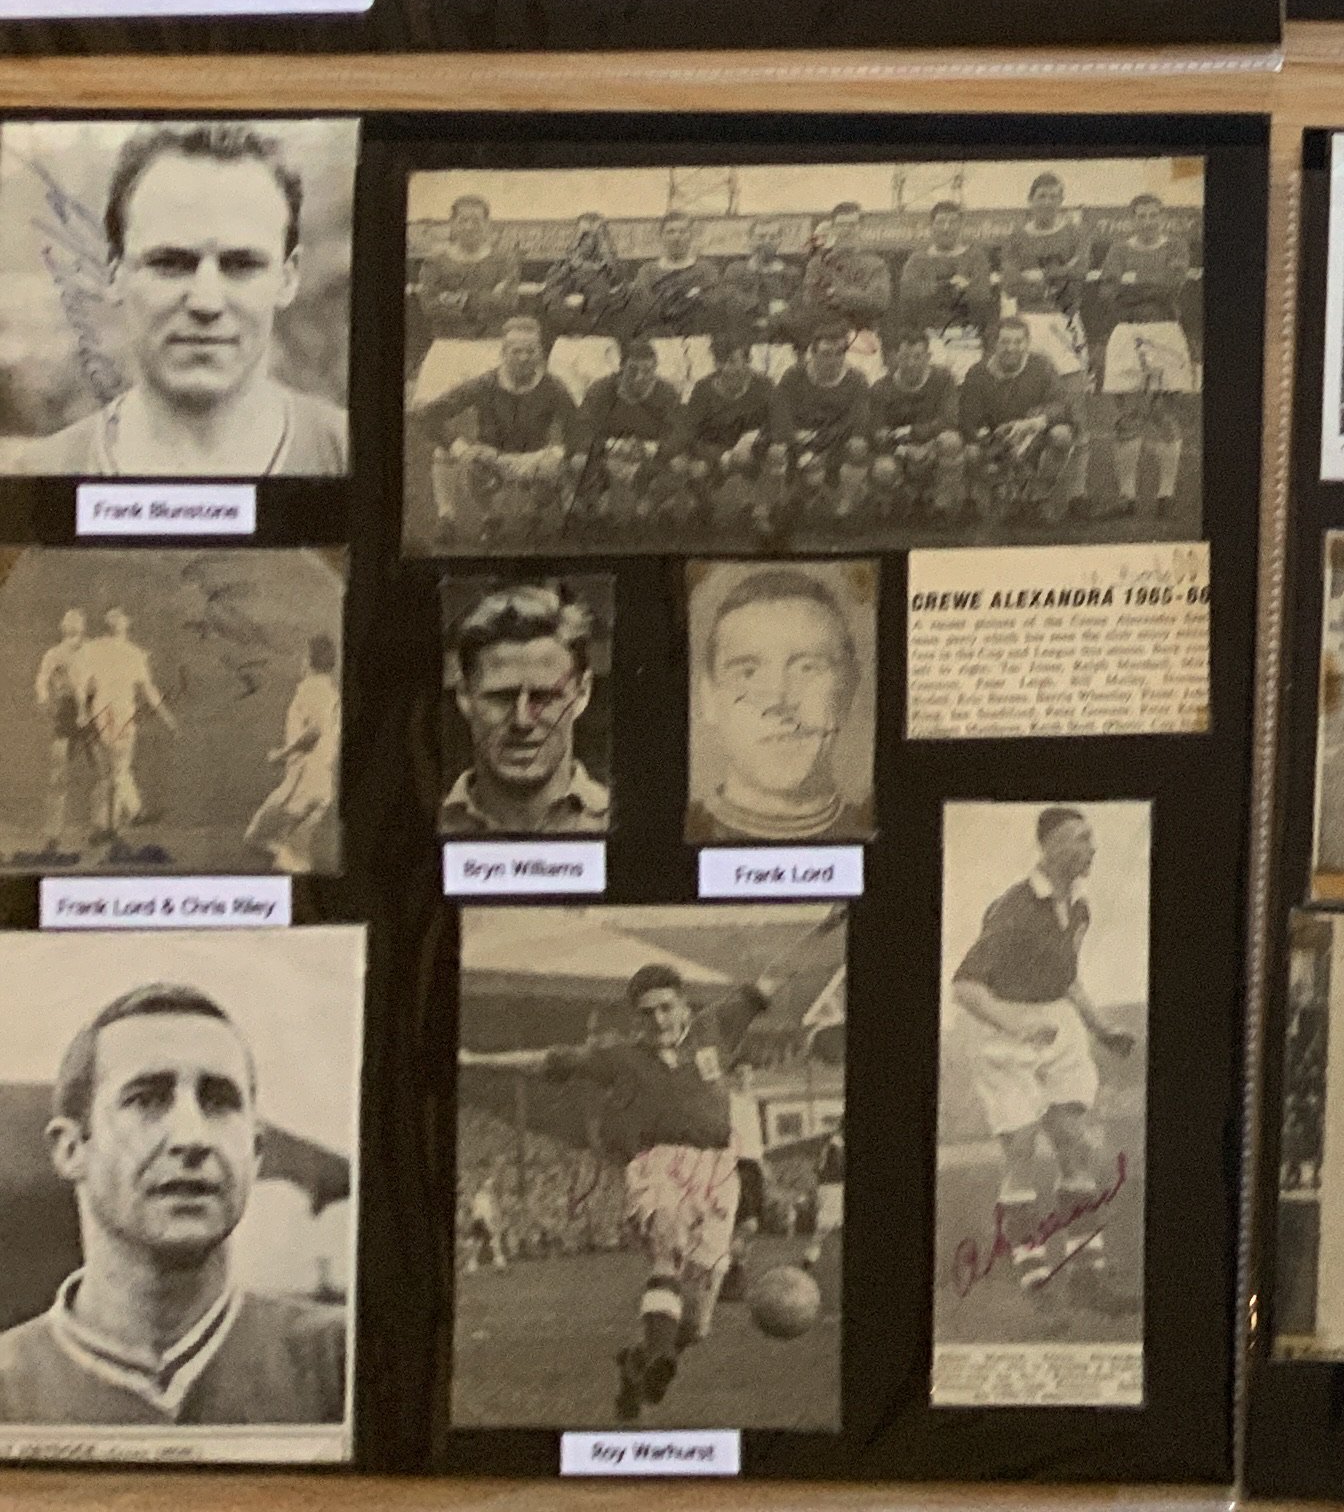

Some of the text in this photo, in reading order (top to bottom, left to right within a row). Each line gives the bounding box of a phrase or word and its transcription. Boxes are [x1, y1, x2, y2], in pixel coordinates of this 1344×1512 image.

[93, 501, 143, 518] Frank
[912, 590, 983, 611] CREWE
[989, 588, 1115, 610] ALEXANDRA
[463, 859, 506, 881] Bryn
[734, 864, 835, 885] Frank Lord
[56, 898, 107, 916] Frank
[111, 898, 156, 917] Lord
[591, 1441, 627, 1464] Roy
